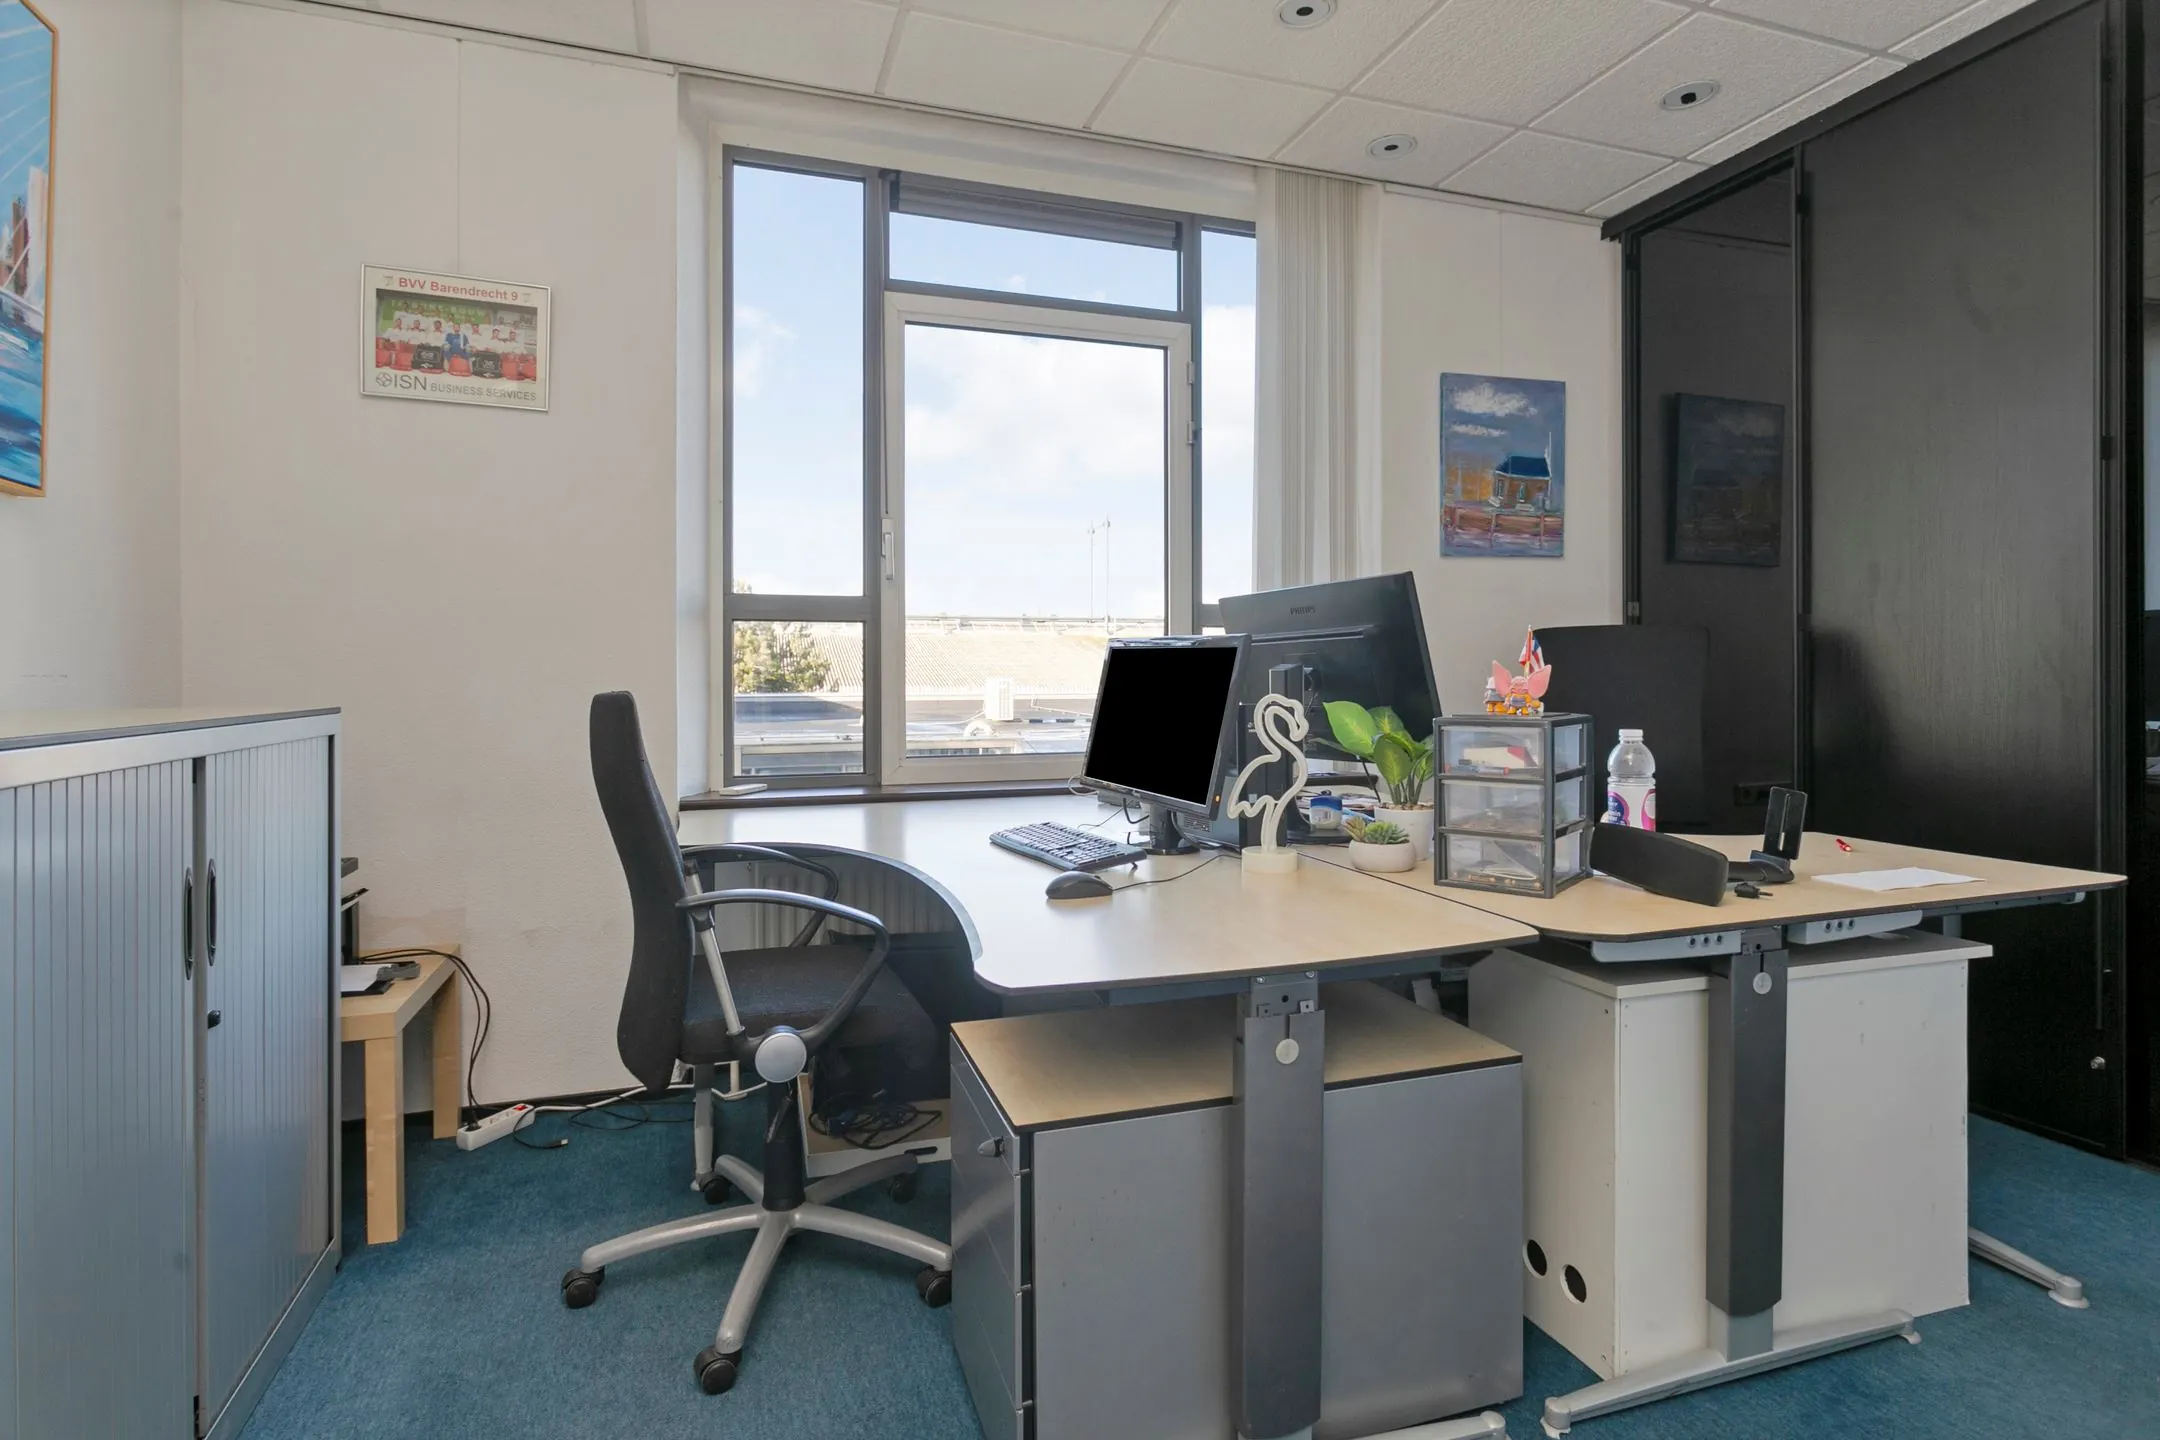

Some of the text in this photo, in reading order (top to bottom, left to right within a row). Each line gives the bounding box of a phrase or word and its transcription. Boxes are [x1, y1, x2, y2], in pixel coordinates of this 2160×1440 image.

[398, 277, 518, 301] BVV Barendrecht 9
[394, 374, 537, 401] ISN BUSINESS SERVICES
